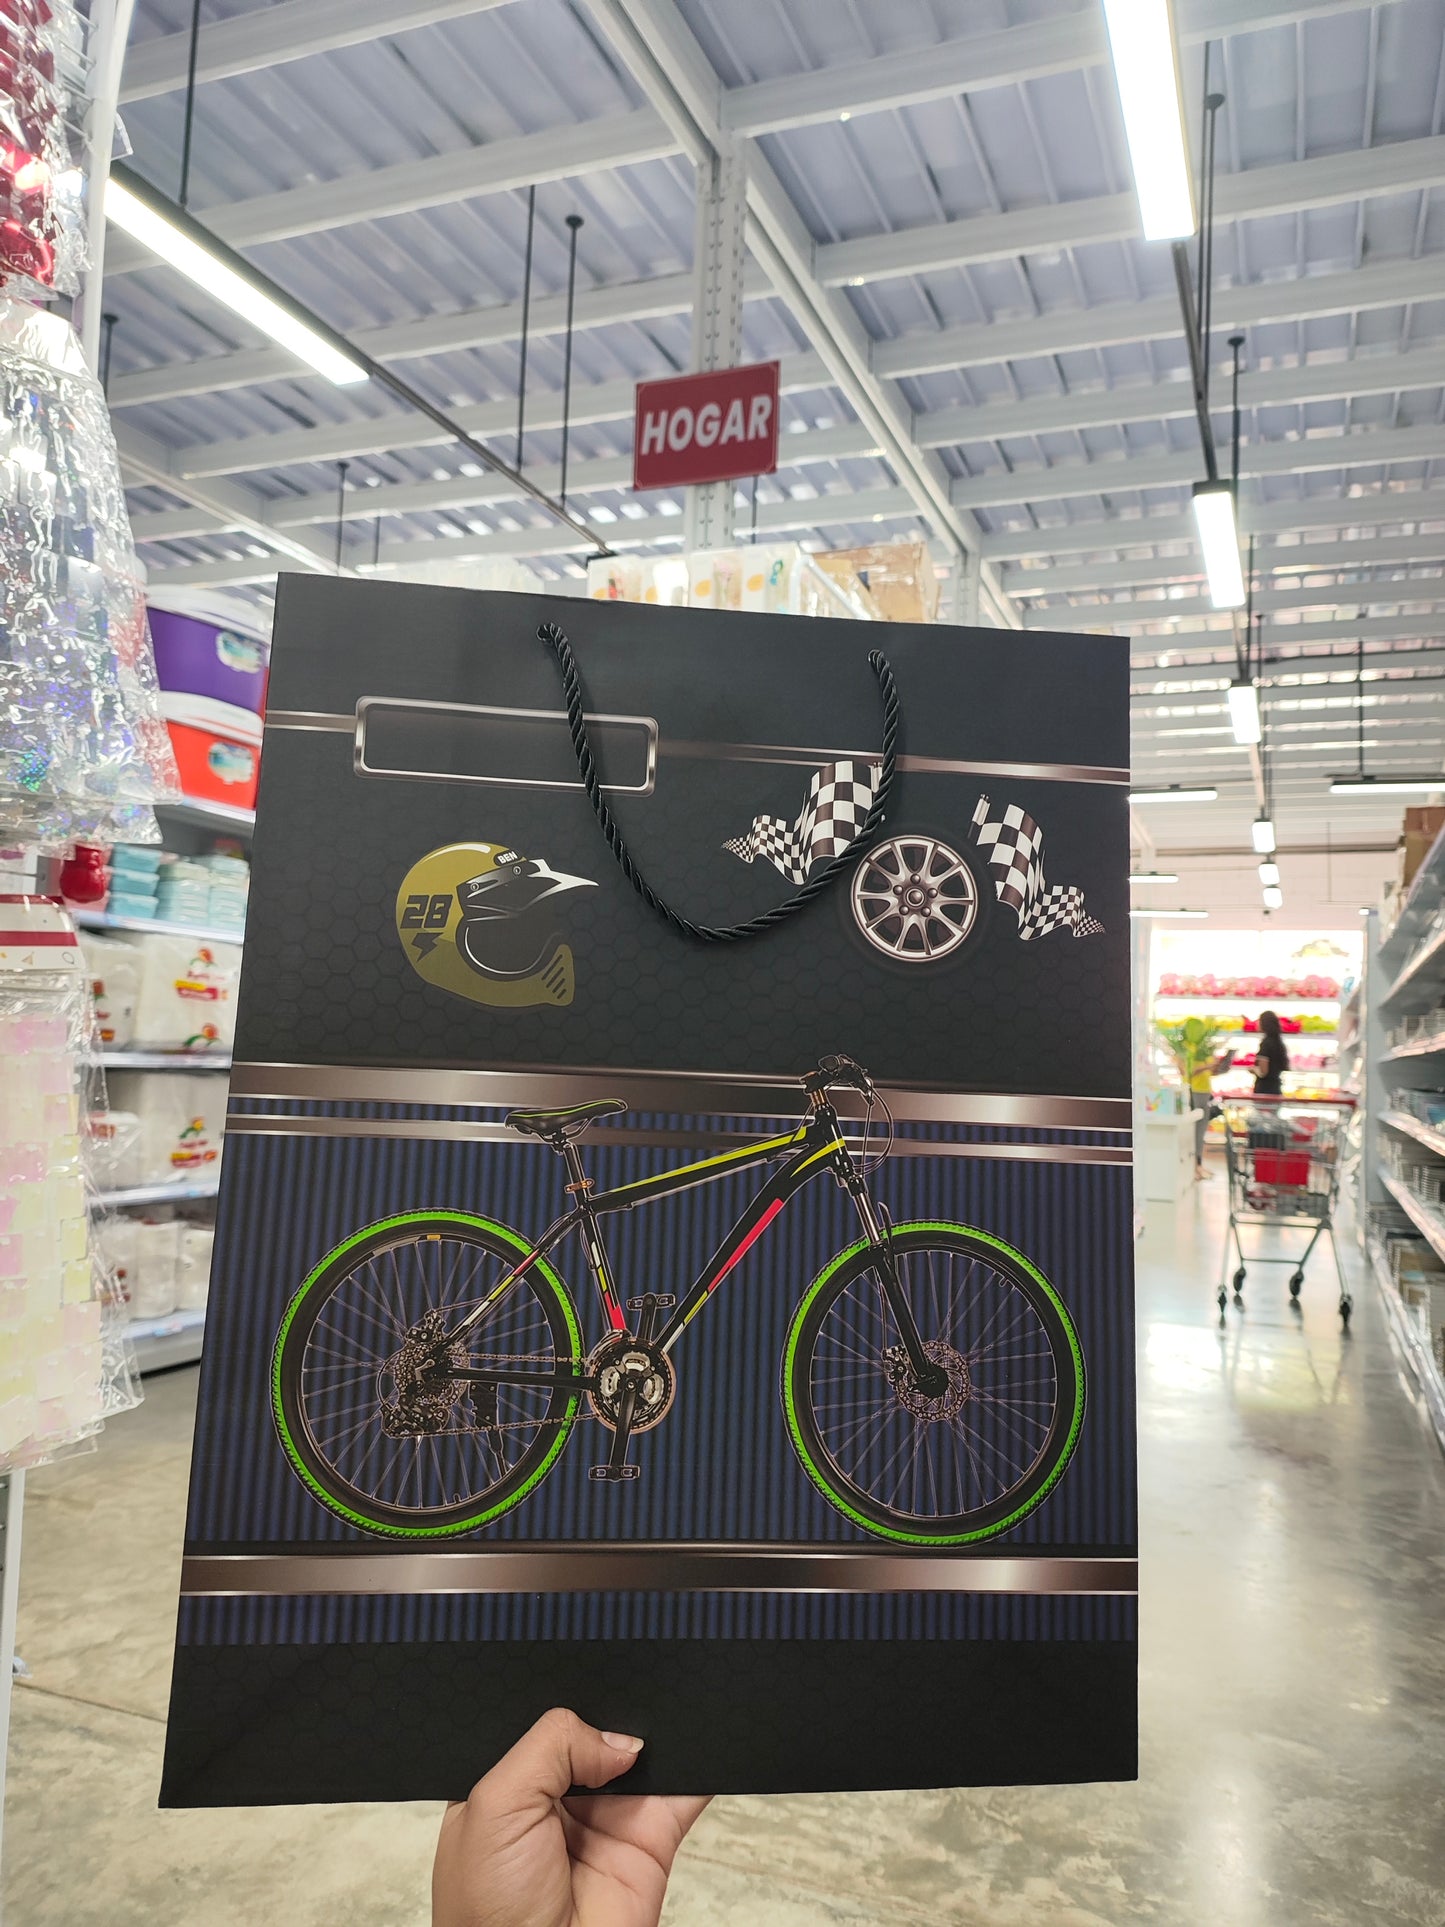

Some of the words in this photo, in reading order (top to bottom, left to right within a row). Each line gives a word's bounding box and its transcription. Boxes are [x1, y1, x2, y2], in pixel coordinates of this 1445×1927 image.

[639, 394, 774, 456] HOGAR
[497, 850, 519, 864] BEN
[400, 894, 454, 930] 28
